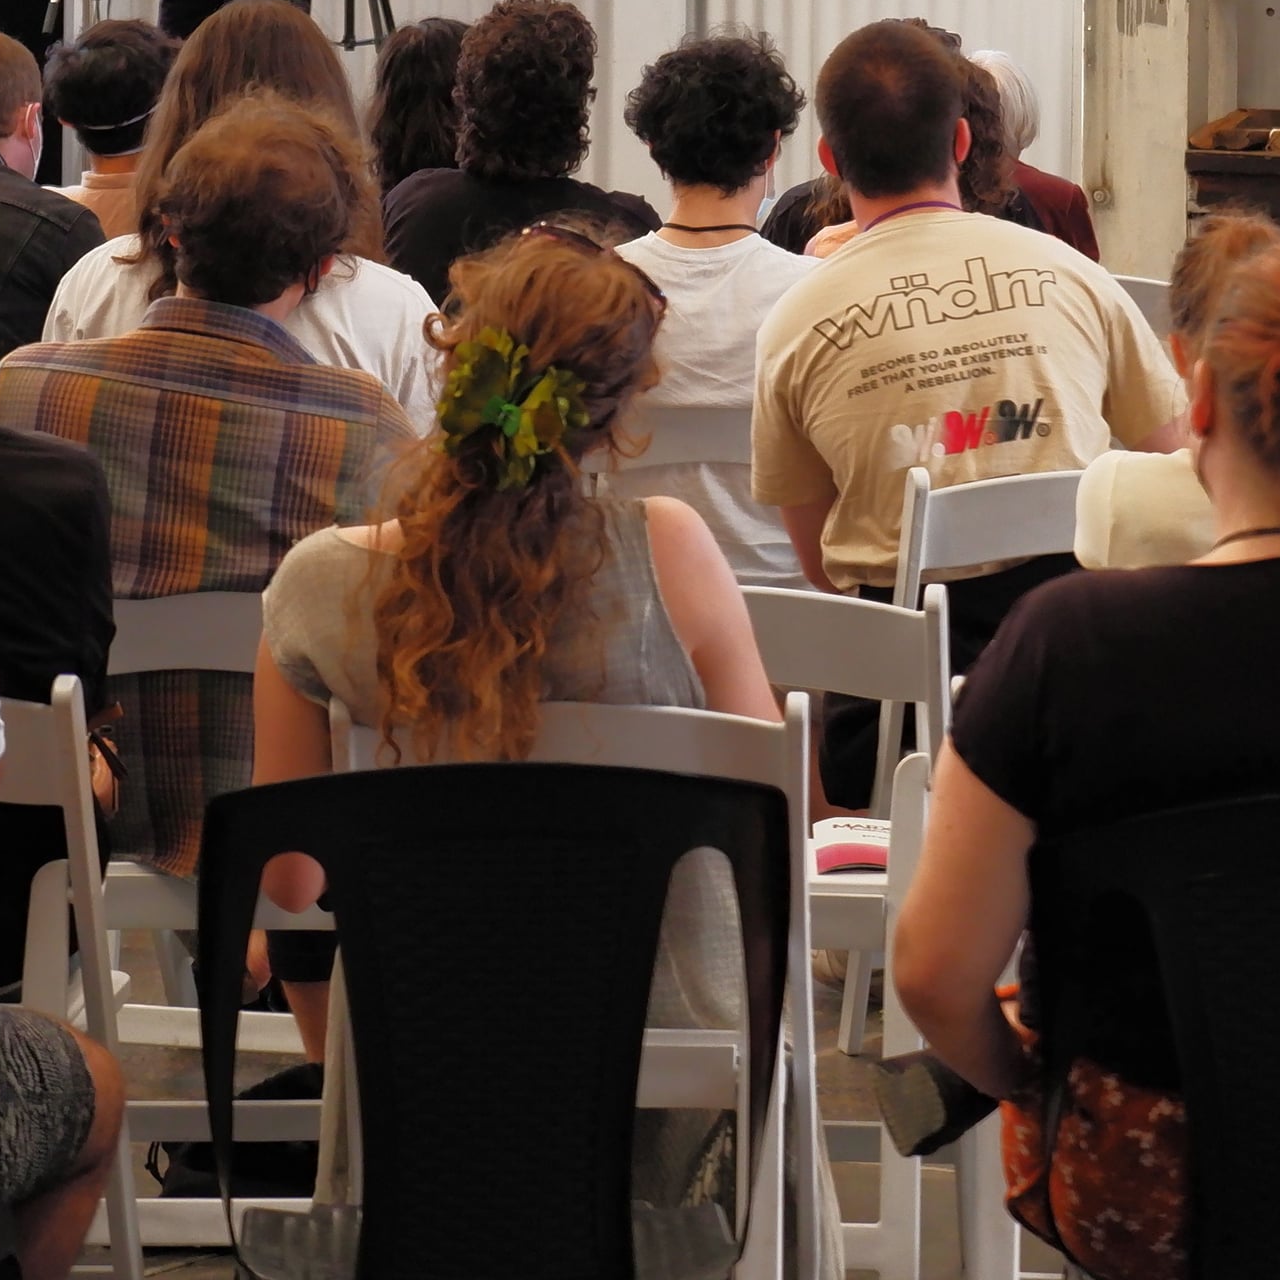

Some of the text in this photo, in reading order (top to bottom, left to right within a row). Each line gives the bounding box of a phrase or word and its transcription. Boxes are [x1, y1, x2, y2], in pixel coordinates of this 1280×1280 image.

[847, 345, 1048, 399] FREE THAT YOUR EXISTENCE IS
[861, 333, 1029, 379] BECOME SO ABSOLUTELY
[904, 366, 996, 394] A REBELLION.
